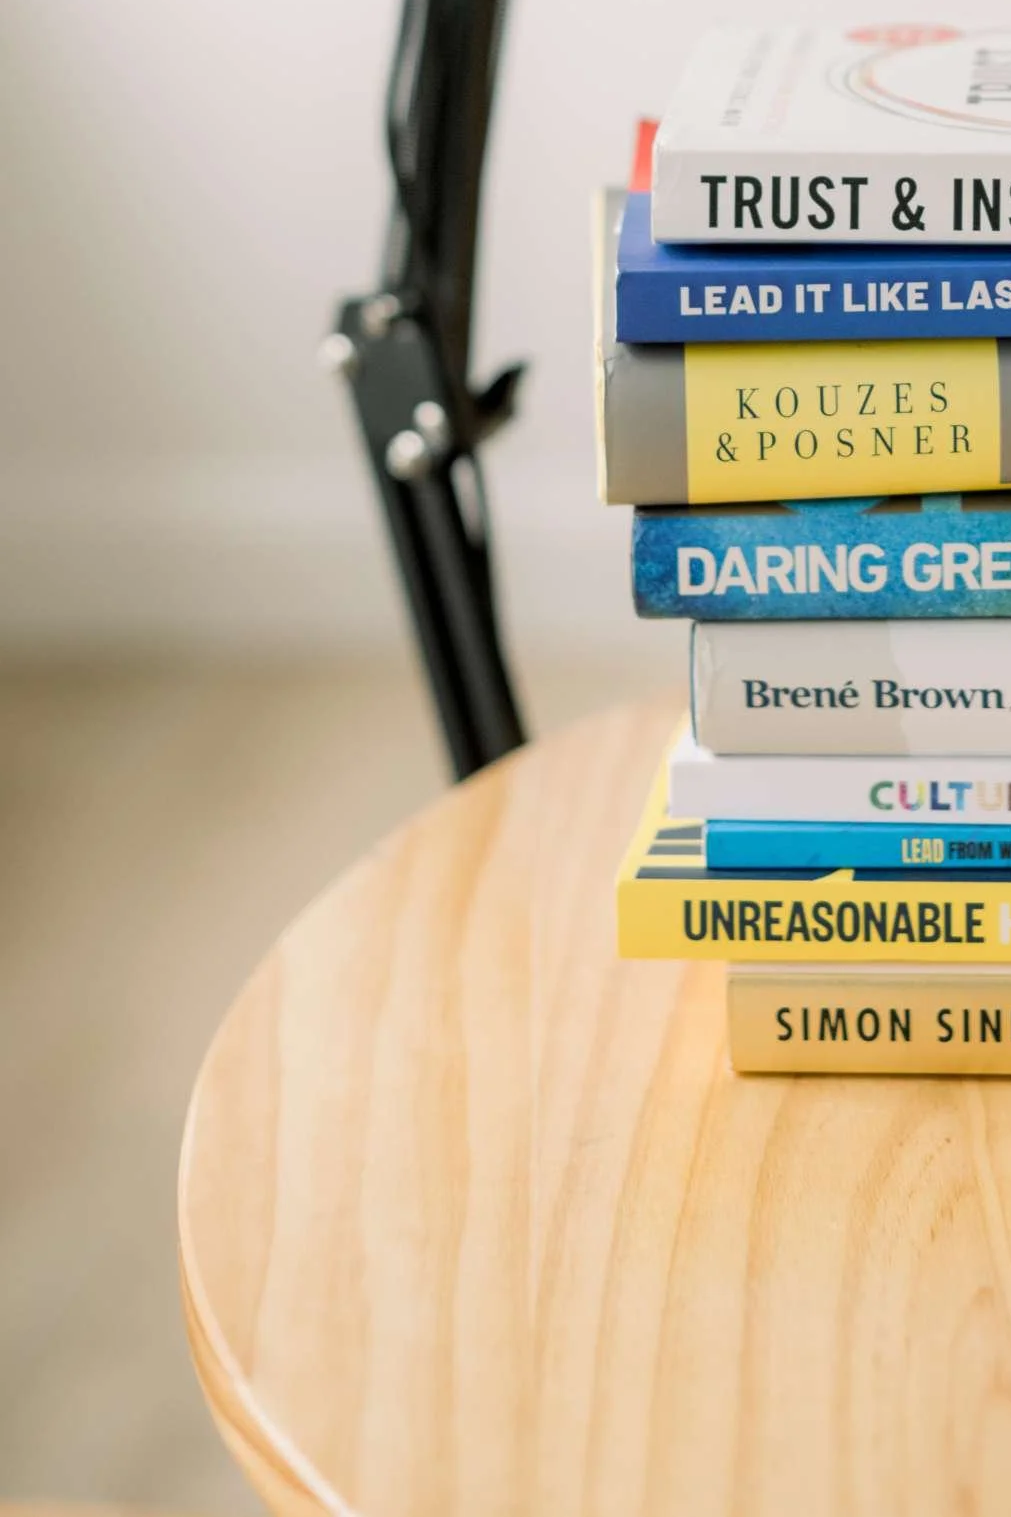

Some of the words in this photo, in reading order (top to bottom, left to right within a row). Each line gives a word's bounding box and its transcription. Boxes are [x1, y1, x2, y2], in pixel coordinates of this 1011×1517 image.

[701, 176, 868, 230] TRUST
[892, 177, 925, 231] &
[680, 285, 782, 315] LEAD
[796, 284, 830, 313] IT
[844, 282, 928, 312] LIKE
[736, 382, 947, 419] KOUZES
[677, 546, 888, 596] DARING
[743, 680, 859, 708] Brené
[902, 838, 944, 863] LEAD
[948, 841, 993, 860] FROM
[684, 900, 984, 943] UNREASONABLE
[777, 1008, 910, 1042] SIMON
